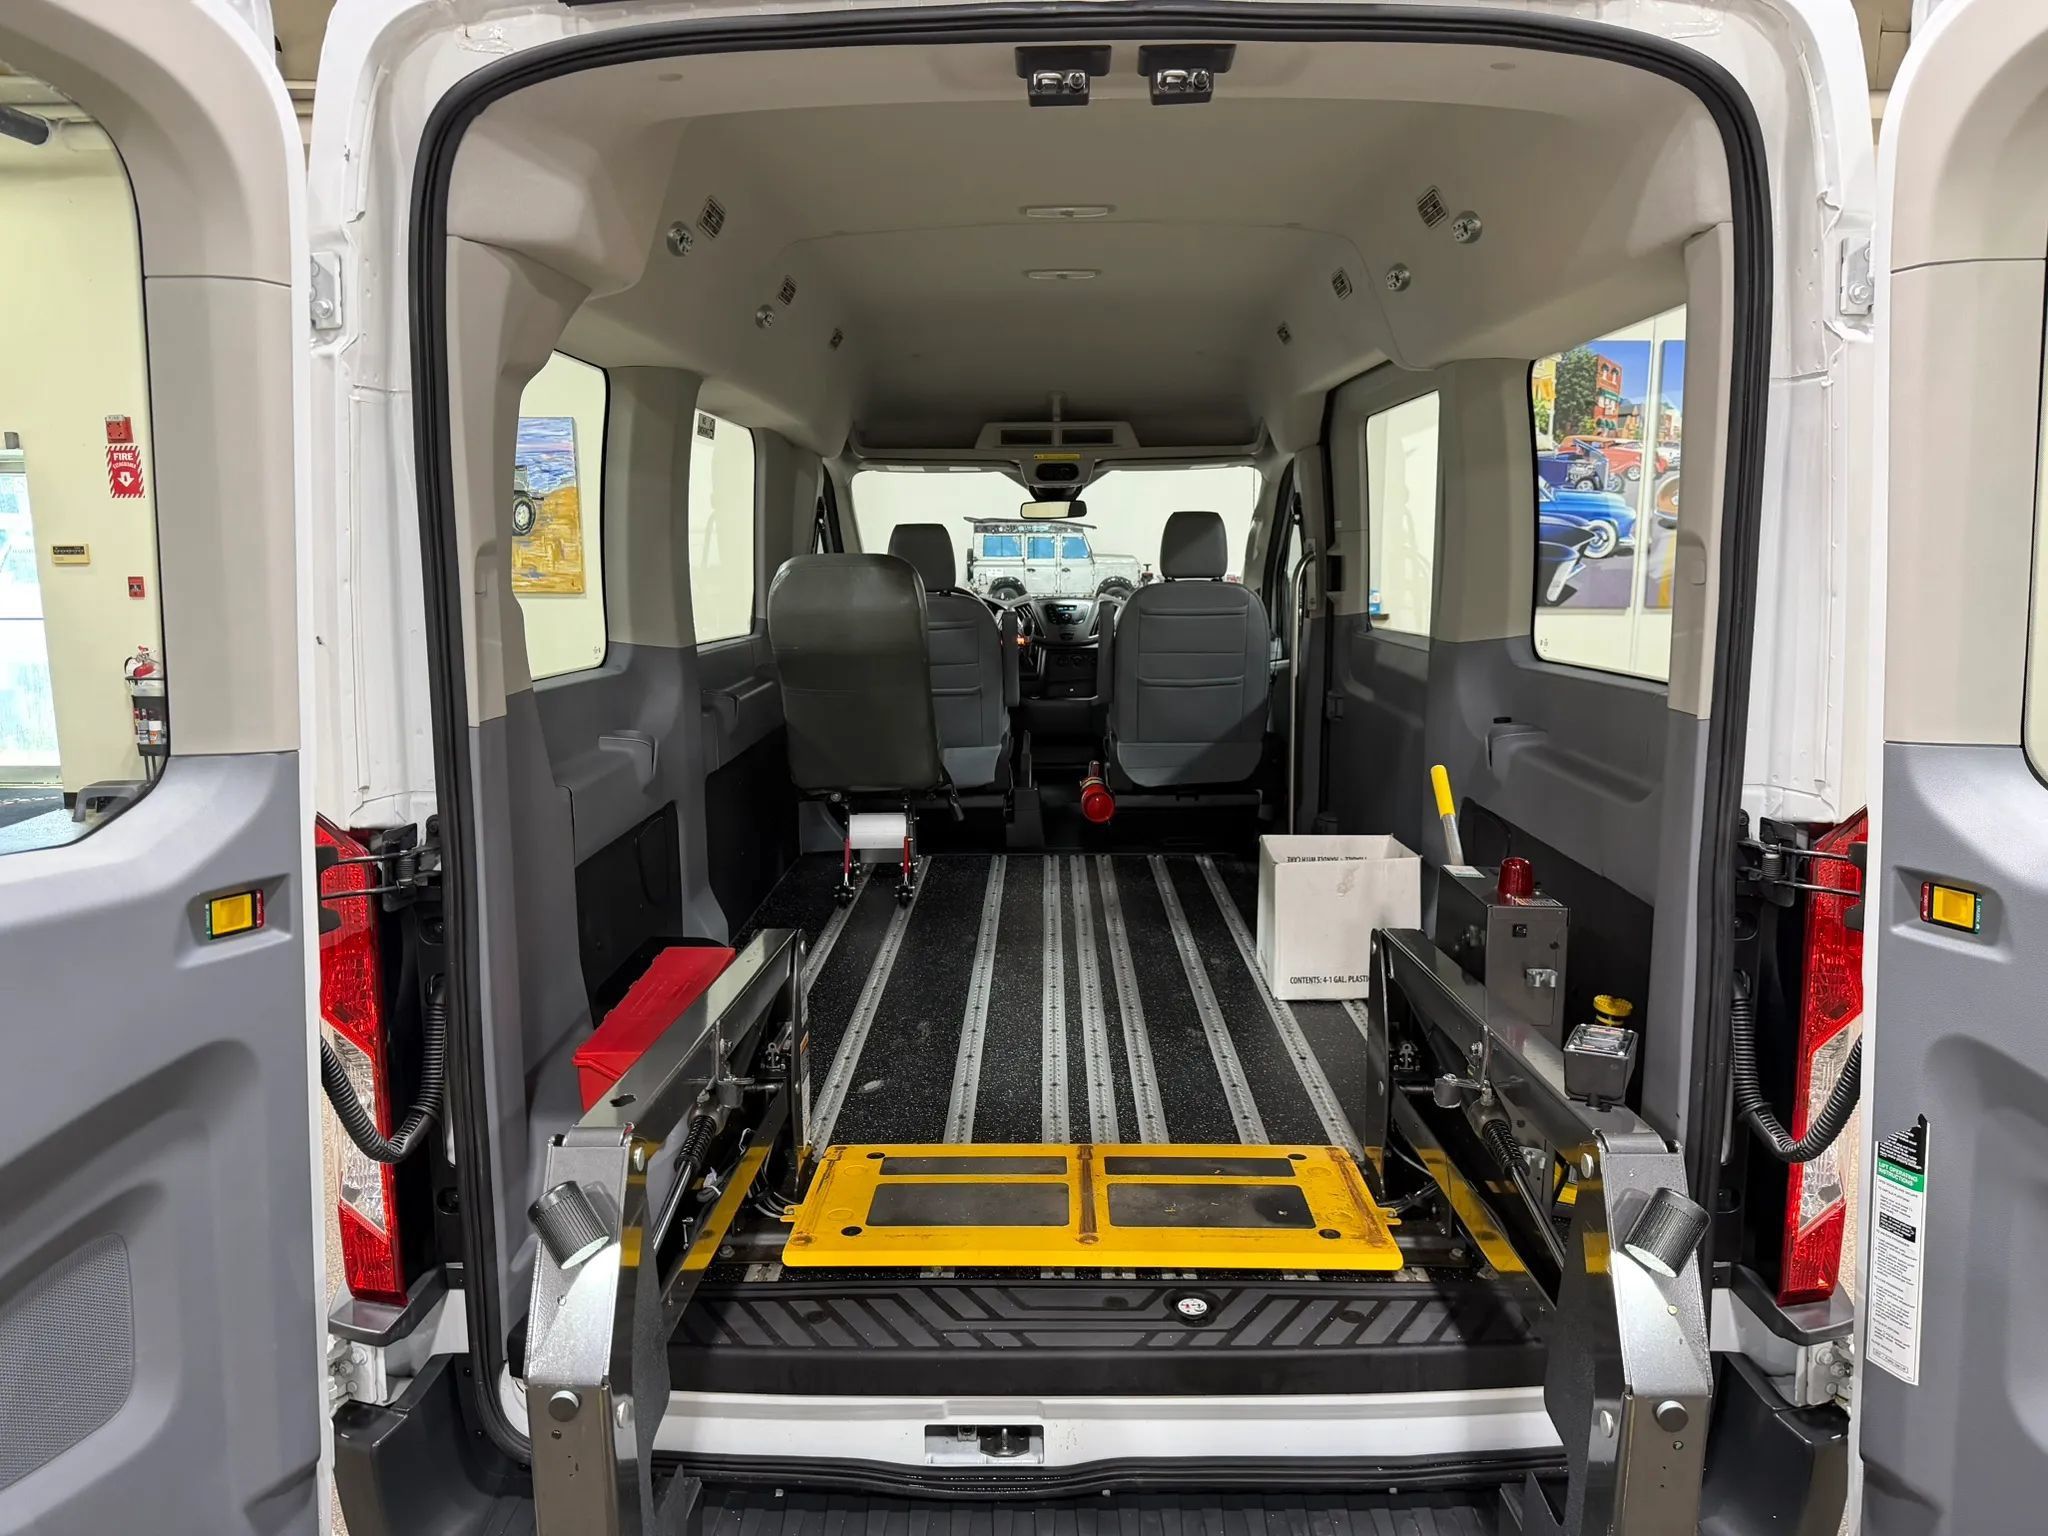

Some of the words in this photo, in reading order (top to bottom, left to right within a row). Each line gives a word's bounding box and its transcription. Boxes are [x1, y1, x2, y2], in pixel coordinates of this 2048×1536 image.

[113, 452, 134, 461] FIRE
[1289, 976, 1322, 984] CONTENTS:
[1333, 975, 1347, 983] GAL.
[1347, 974, 1369, 983] PLASTI
